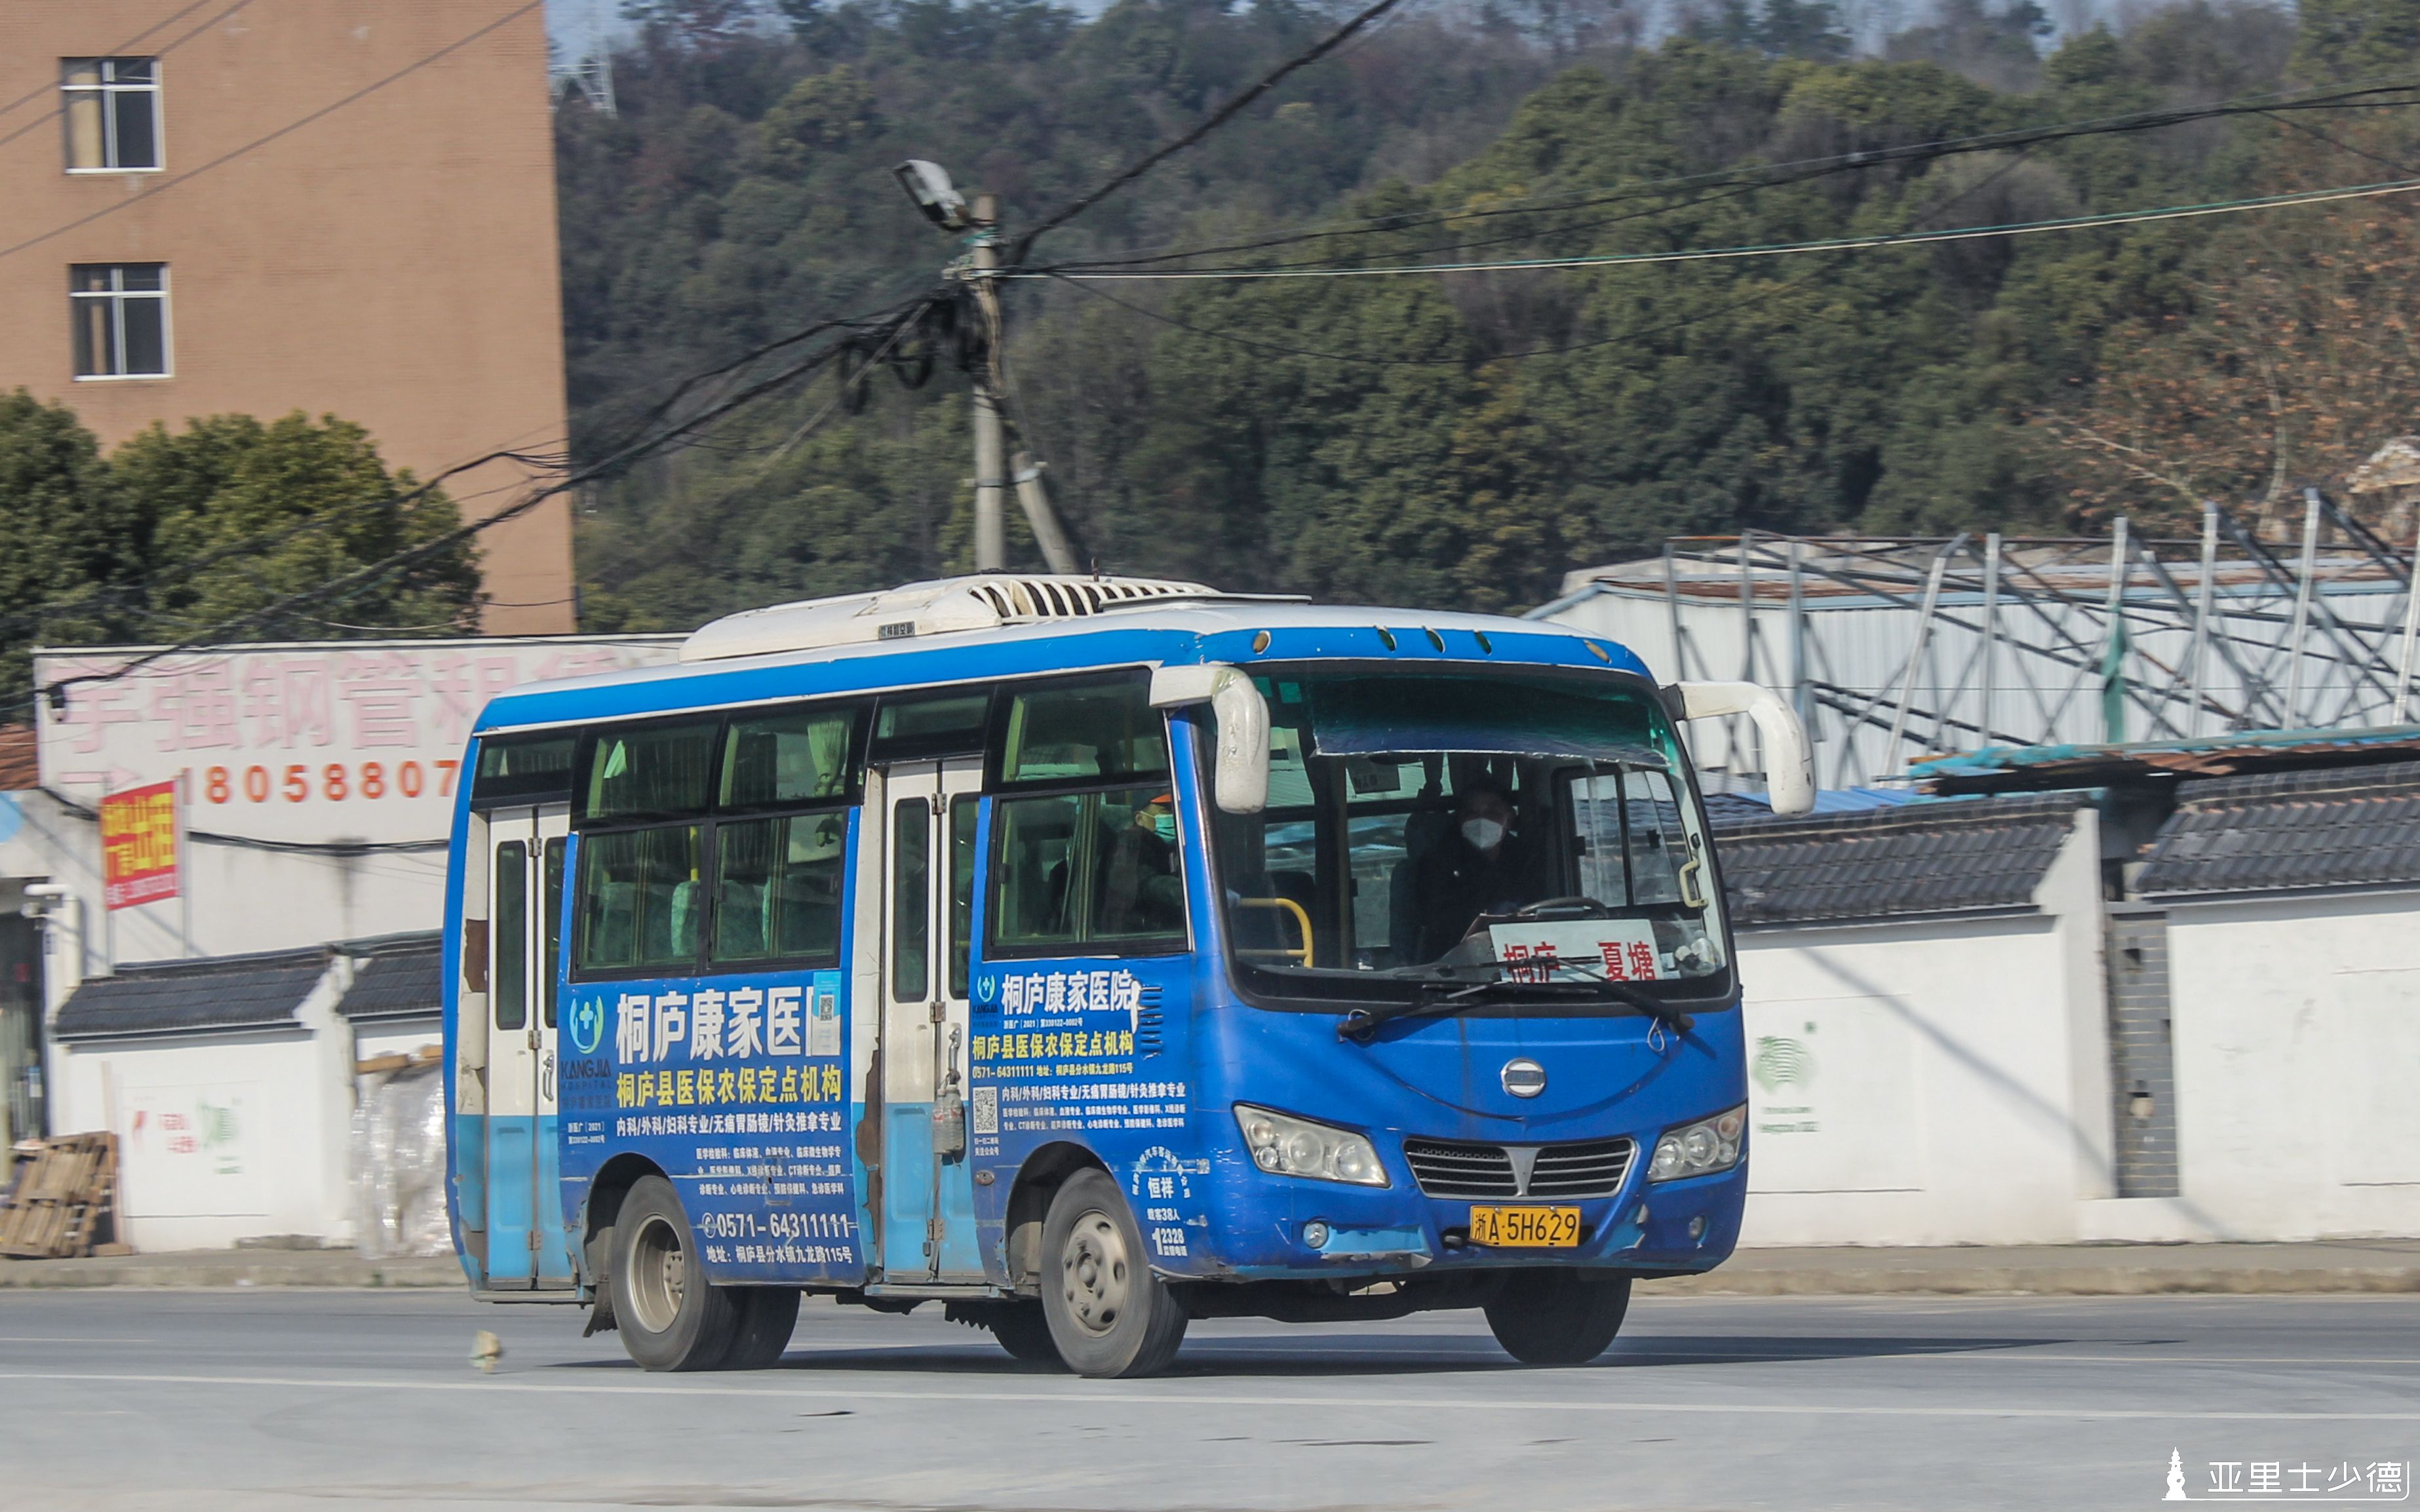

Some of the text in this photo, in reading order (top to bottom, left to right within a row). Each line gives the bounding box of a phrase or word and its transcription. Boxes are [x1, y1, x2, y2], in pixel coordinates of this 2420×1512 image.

[1597, 940, 1656, 982] 夏塘
[1001, 969, 1134, 1016] 桐庐康家医院
[615, 986, 811, 1064] 桐庐康家医
[973, 1030, 1134, 1060] 桐庐县医保农保定点机构
[561, 1058, 611, 1079] KANGJIA
[616, 1064, 842, 1108] 桐庐县医保农保定点机构
[616, 1111, 842, 1136] 内科/外科/妇科专业/无痛胃肠镜/针灸推拿专业
[1148, 1176, 1175, 1199] 恒祥
[1152, 1227, 1185, 1256] 12328
